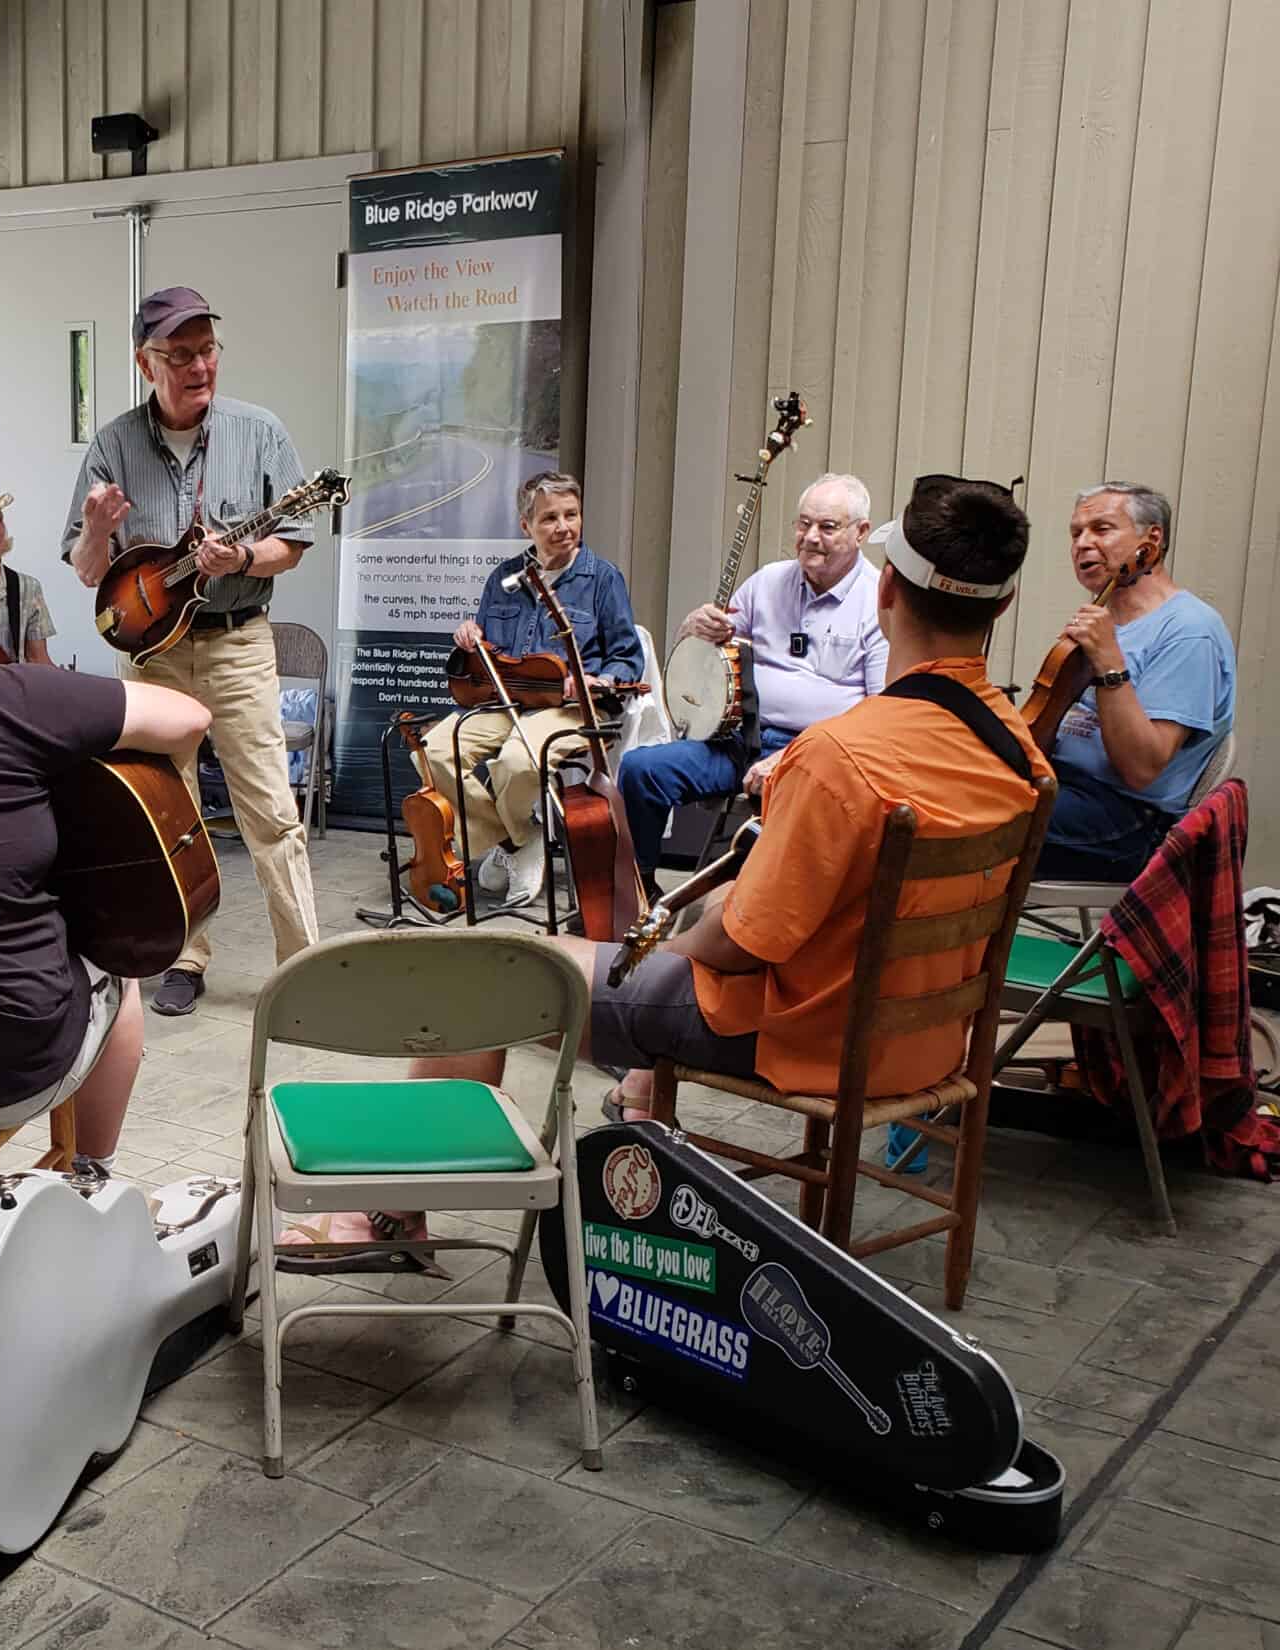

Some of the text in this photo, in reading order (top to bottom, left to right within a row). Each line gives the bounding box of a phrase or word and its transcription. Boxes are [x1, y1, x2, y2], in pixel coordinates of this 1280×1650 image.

[365, 189, 538, 225] Blue Ridge Parkway
[373, 257, 495, 288] Enjoy the View
[385, 286, 519, 313] Watch the Road
[386, 553, 437, 565] wonderful
[440, 554, 469, 567] things
[472, 554, 482, 565] to
[427, 574, 442, 584] the
[470, 575, 485, 584] the
[364, 594, 380, 604] the
[382, 594, 417, 606] curves,
[420, 594, 436, 605] the
[439, 595, 470, 607] traffic,
[388, 608, 400, 618] 45
[403, 609, 427, 621] mph
[430, 609, 460, 621] speed
[357, 648, 371, 657] The
[373, 648, 391, 658] Blue
[393, 649, 417, 660] Ridge
[351, 662, 396, 674] potentially
[351, 677, 384, 686] respond
[386, 678, 395, 686] to
[397, 678, 438, 688] hundreds
[378, 692, 401, 702] Don't
[403, 694, 420, 703] ruin
[585, 1224, 711, 1283] live the life you love
[617, 1283, 749, 1369] BLUEGRASS
[767, 1288, 825, 1356] LOVE
[919, 1361, 938, 1392] The
[903, 1374, 931, 1428] Brothers
